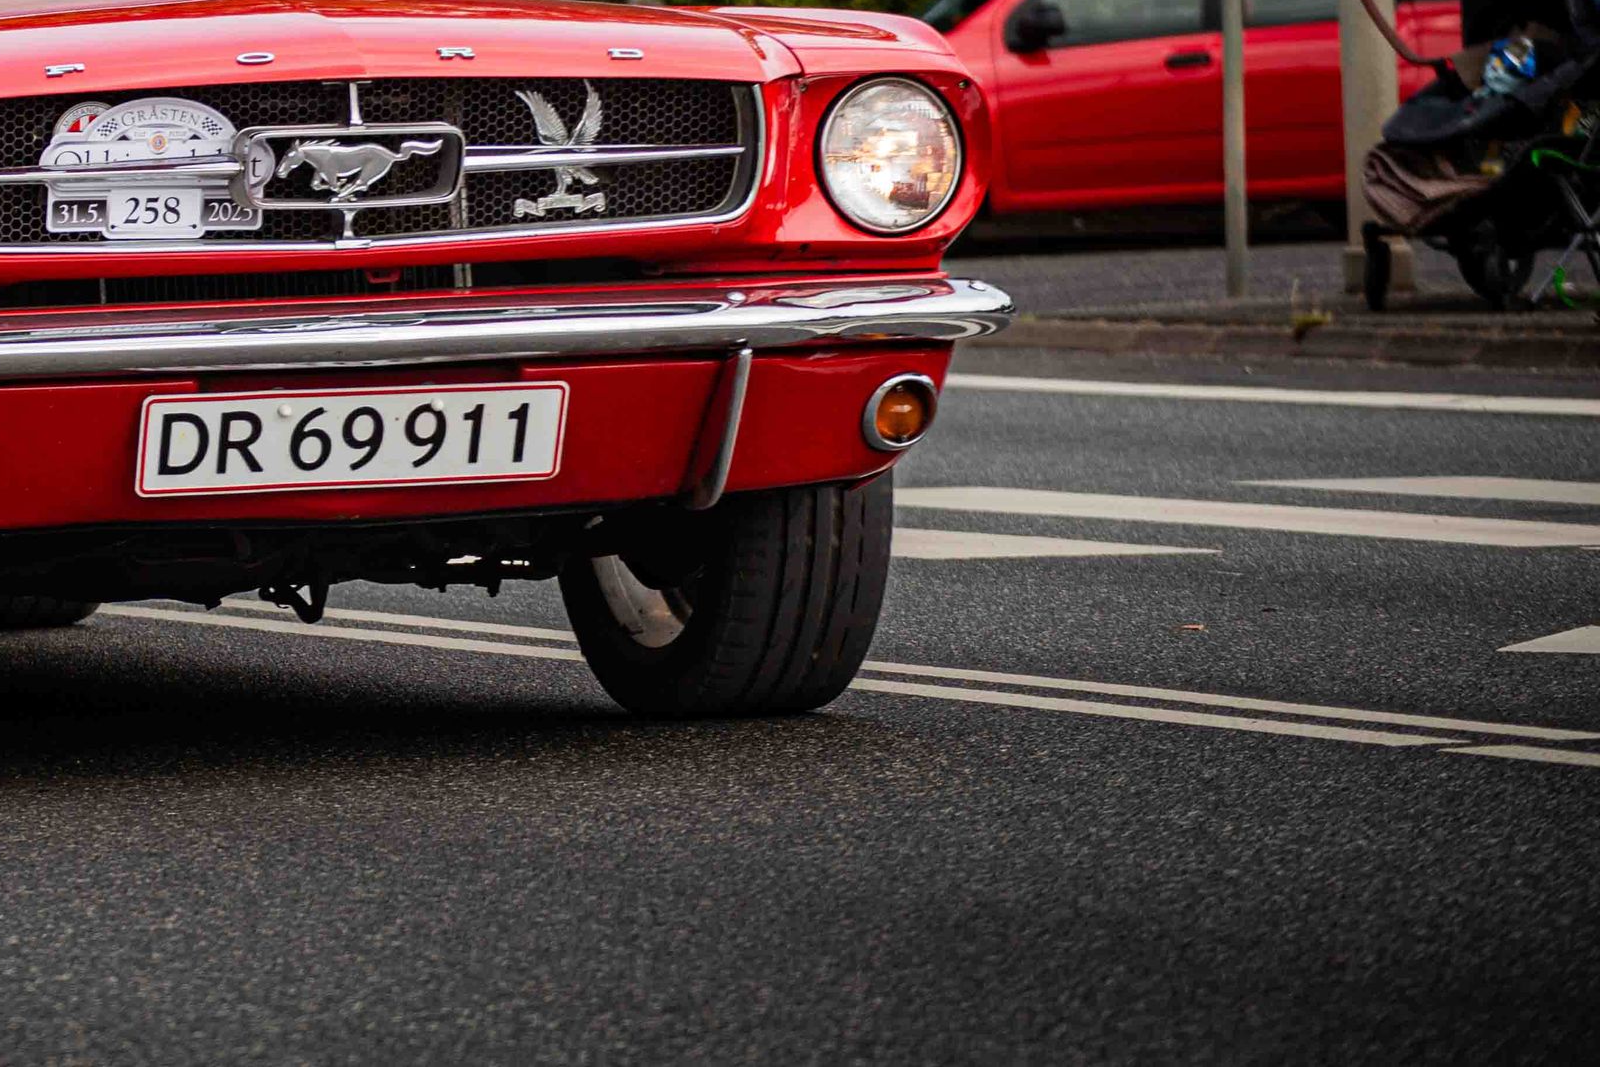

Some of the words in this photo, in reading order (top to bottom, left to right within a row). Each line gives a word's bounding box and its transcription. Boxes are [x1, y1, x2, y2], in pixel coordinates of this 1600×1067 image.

[44, 46, 644, 76] FORD
[121, 105, 200, 126] GRÅSTEN
[123, 196, 181, 224] 258
[208, 201, 253, 222] 2025
[157, 411, 263, 475] DR
[289, 406, 384, 472] 69
[404, 402, 530, 468] 911
